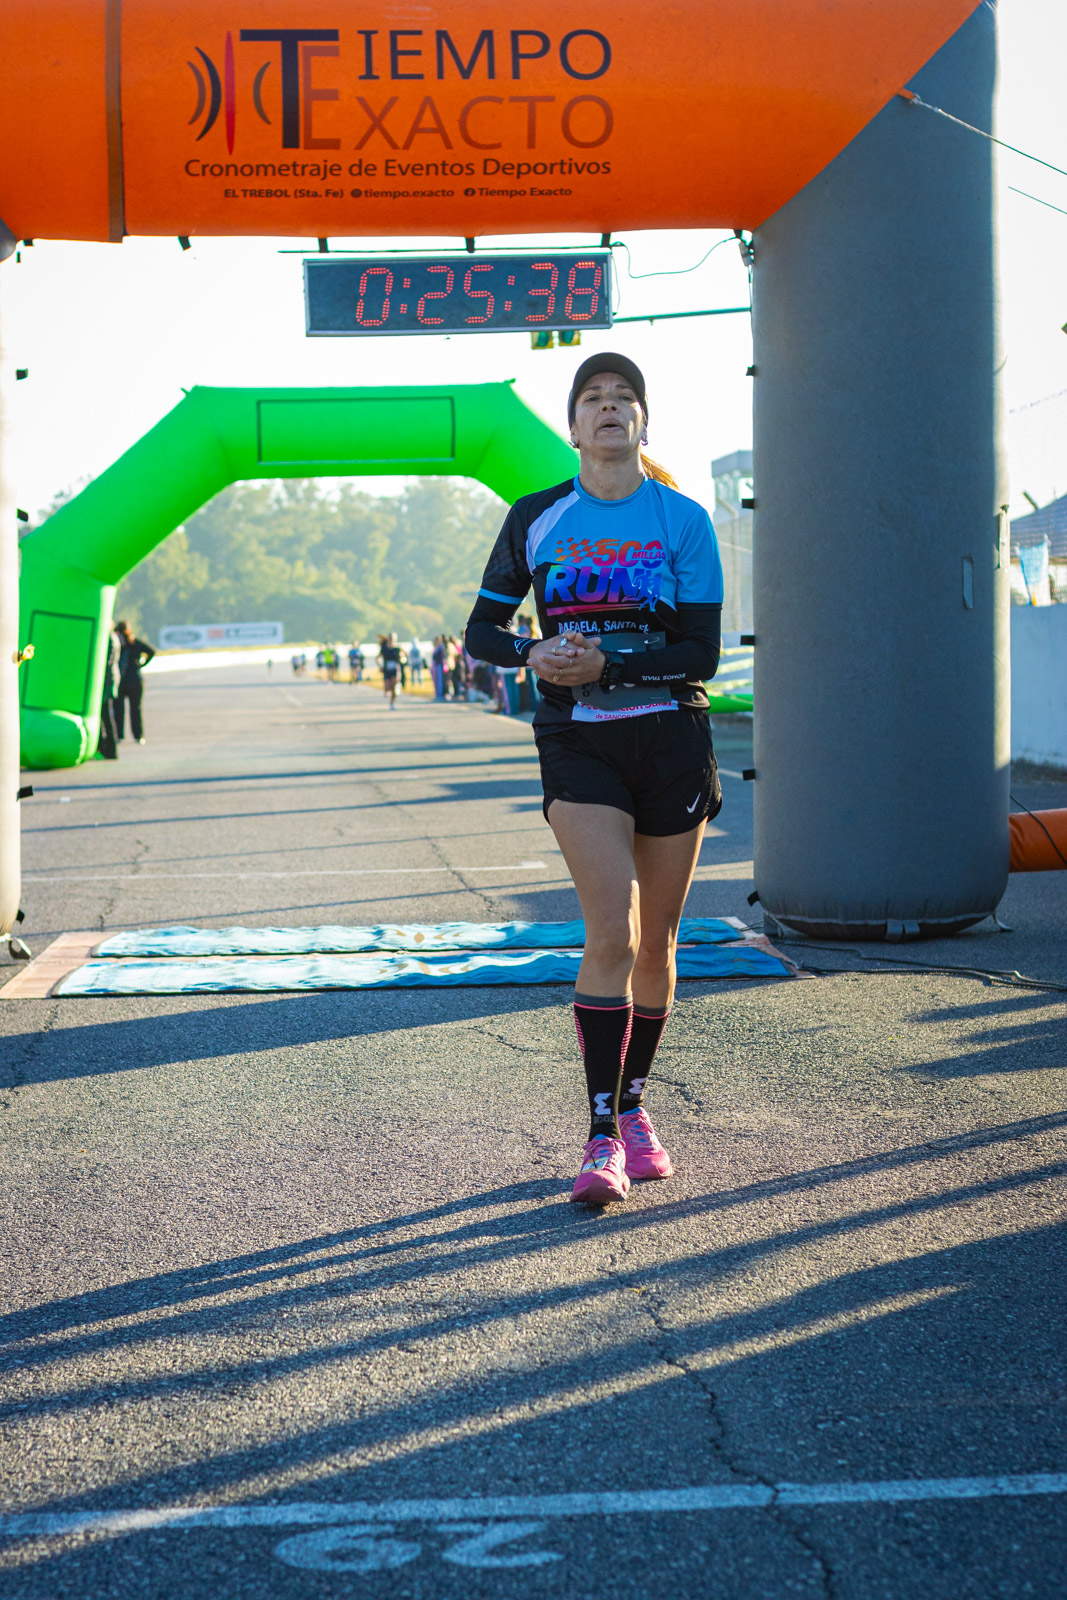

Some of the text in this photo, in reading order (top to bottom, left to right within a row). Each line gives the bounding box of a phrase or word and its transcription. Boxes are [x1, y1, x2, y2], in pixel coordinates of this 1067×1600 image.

[184, 157, 612, 181] Cronometraje de Eventos Deportivos
[223, 188, 345, 199] EL TREBOL (Sta. Fe)
[363, 187, 455, 200] tiempo.exacto
[477, 186, 573, 199] Tiempo Exacto
[355, 260, 603, 327] 0:25:38
[631, 550, 666, 561] MILLAS
[544, 564, 645, 604] RUN
[558, 620, 601, 635] RAFAELA,
[604, 620, 637, 632] SANTA
